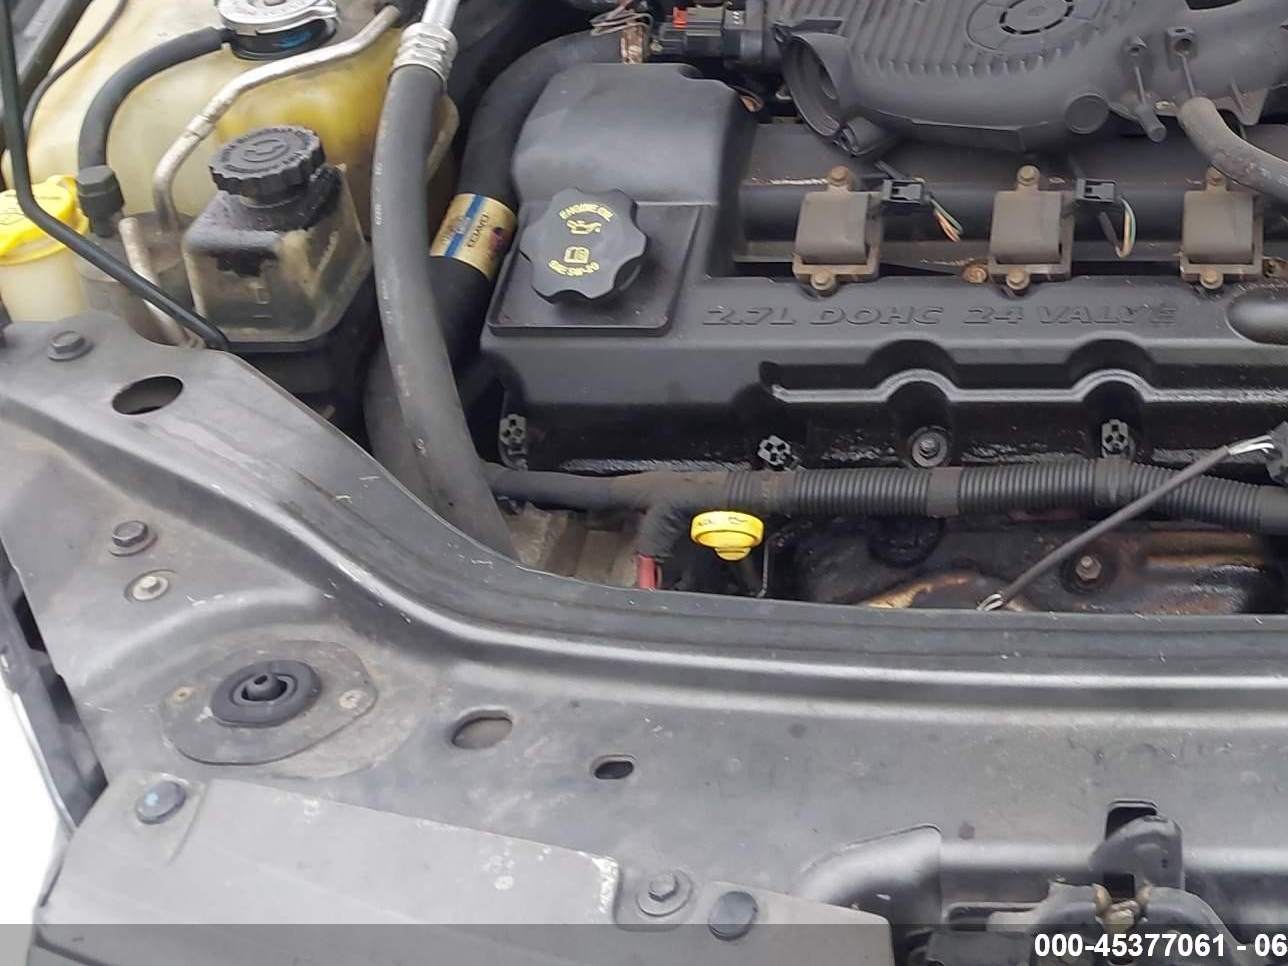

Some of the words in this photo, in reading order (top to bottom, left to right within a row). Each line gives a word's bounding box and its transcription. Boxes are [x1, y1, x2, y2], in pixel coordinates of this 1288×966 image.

[702, 307, 797, 327] 2.7L
[809, 307, 945, 327] DOHC
[963, 306, 1024, 326] 24
[1038, 304, 1180, 327] VALVE
